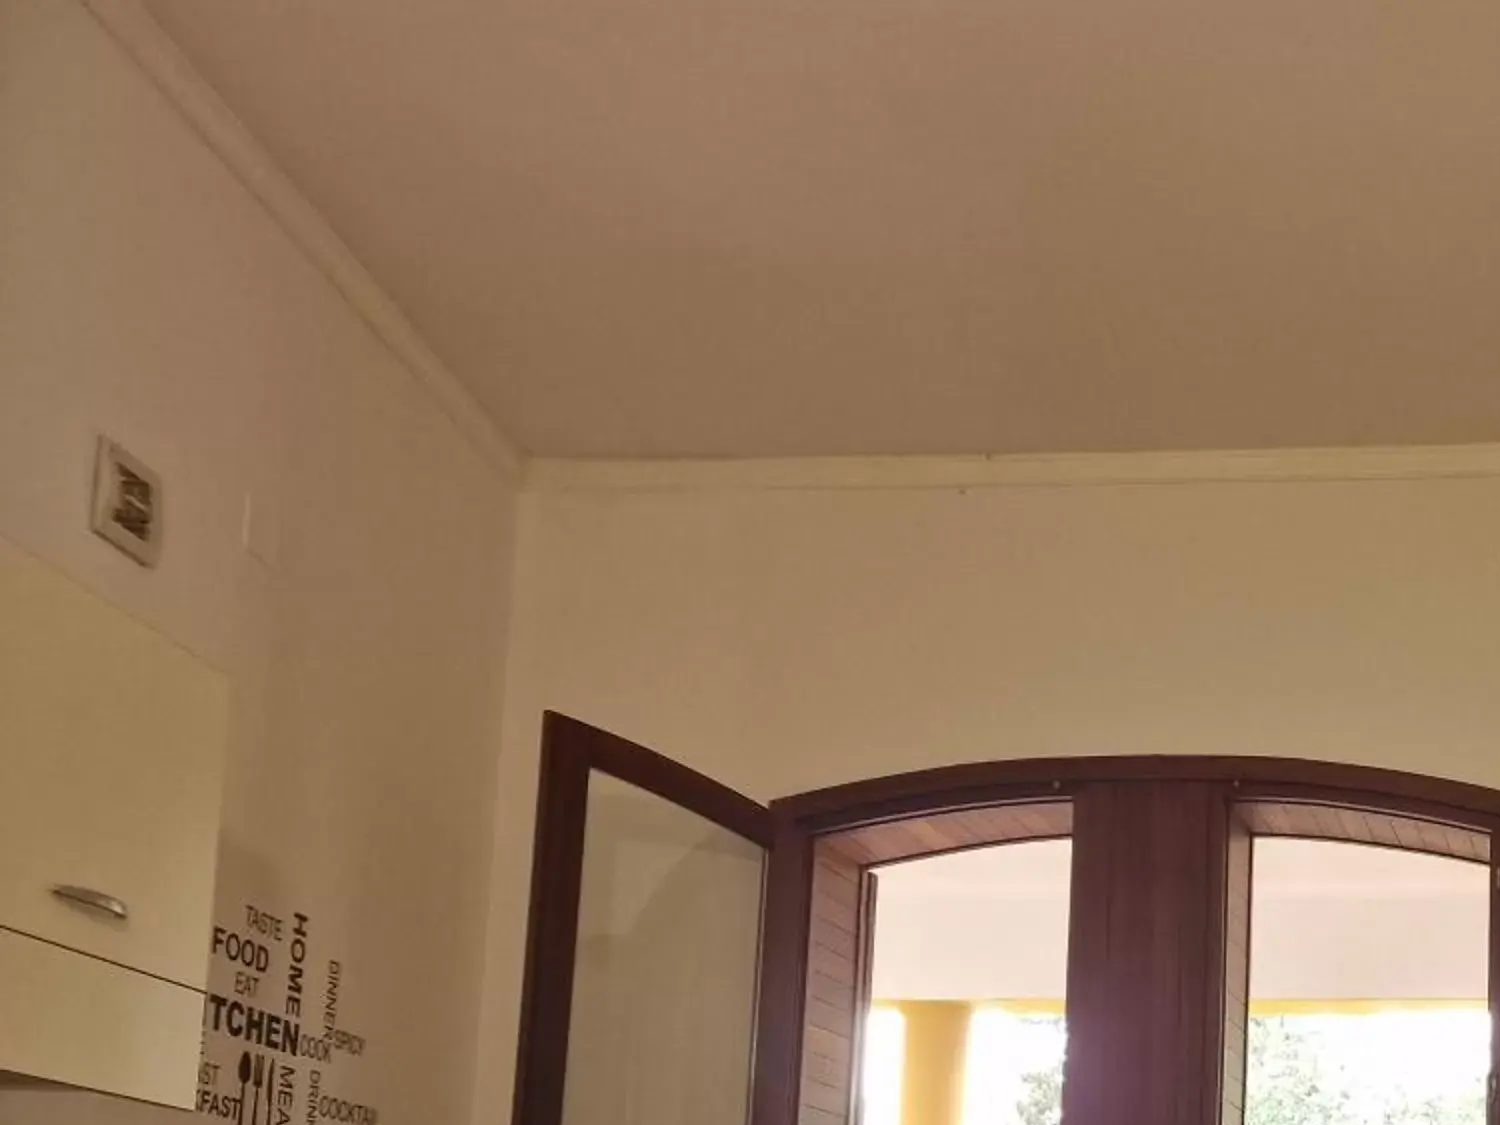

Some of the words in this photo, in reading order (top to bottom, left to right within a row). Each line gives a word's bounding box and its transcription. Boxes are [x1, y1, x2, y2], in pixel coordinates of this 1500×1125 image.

[246, 904, 284, 942] TASTE
[211, 925, 269, 973] FOOD
[285, 911, 309, 1018] HOME
[234, 971, 260, 997] EAT
